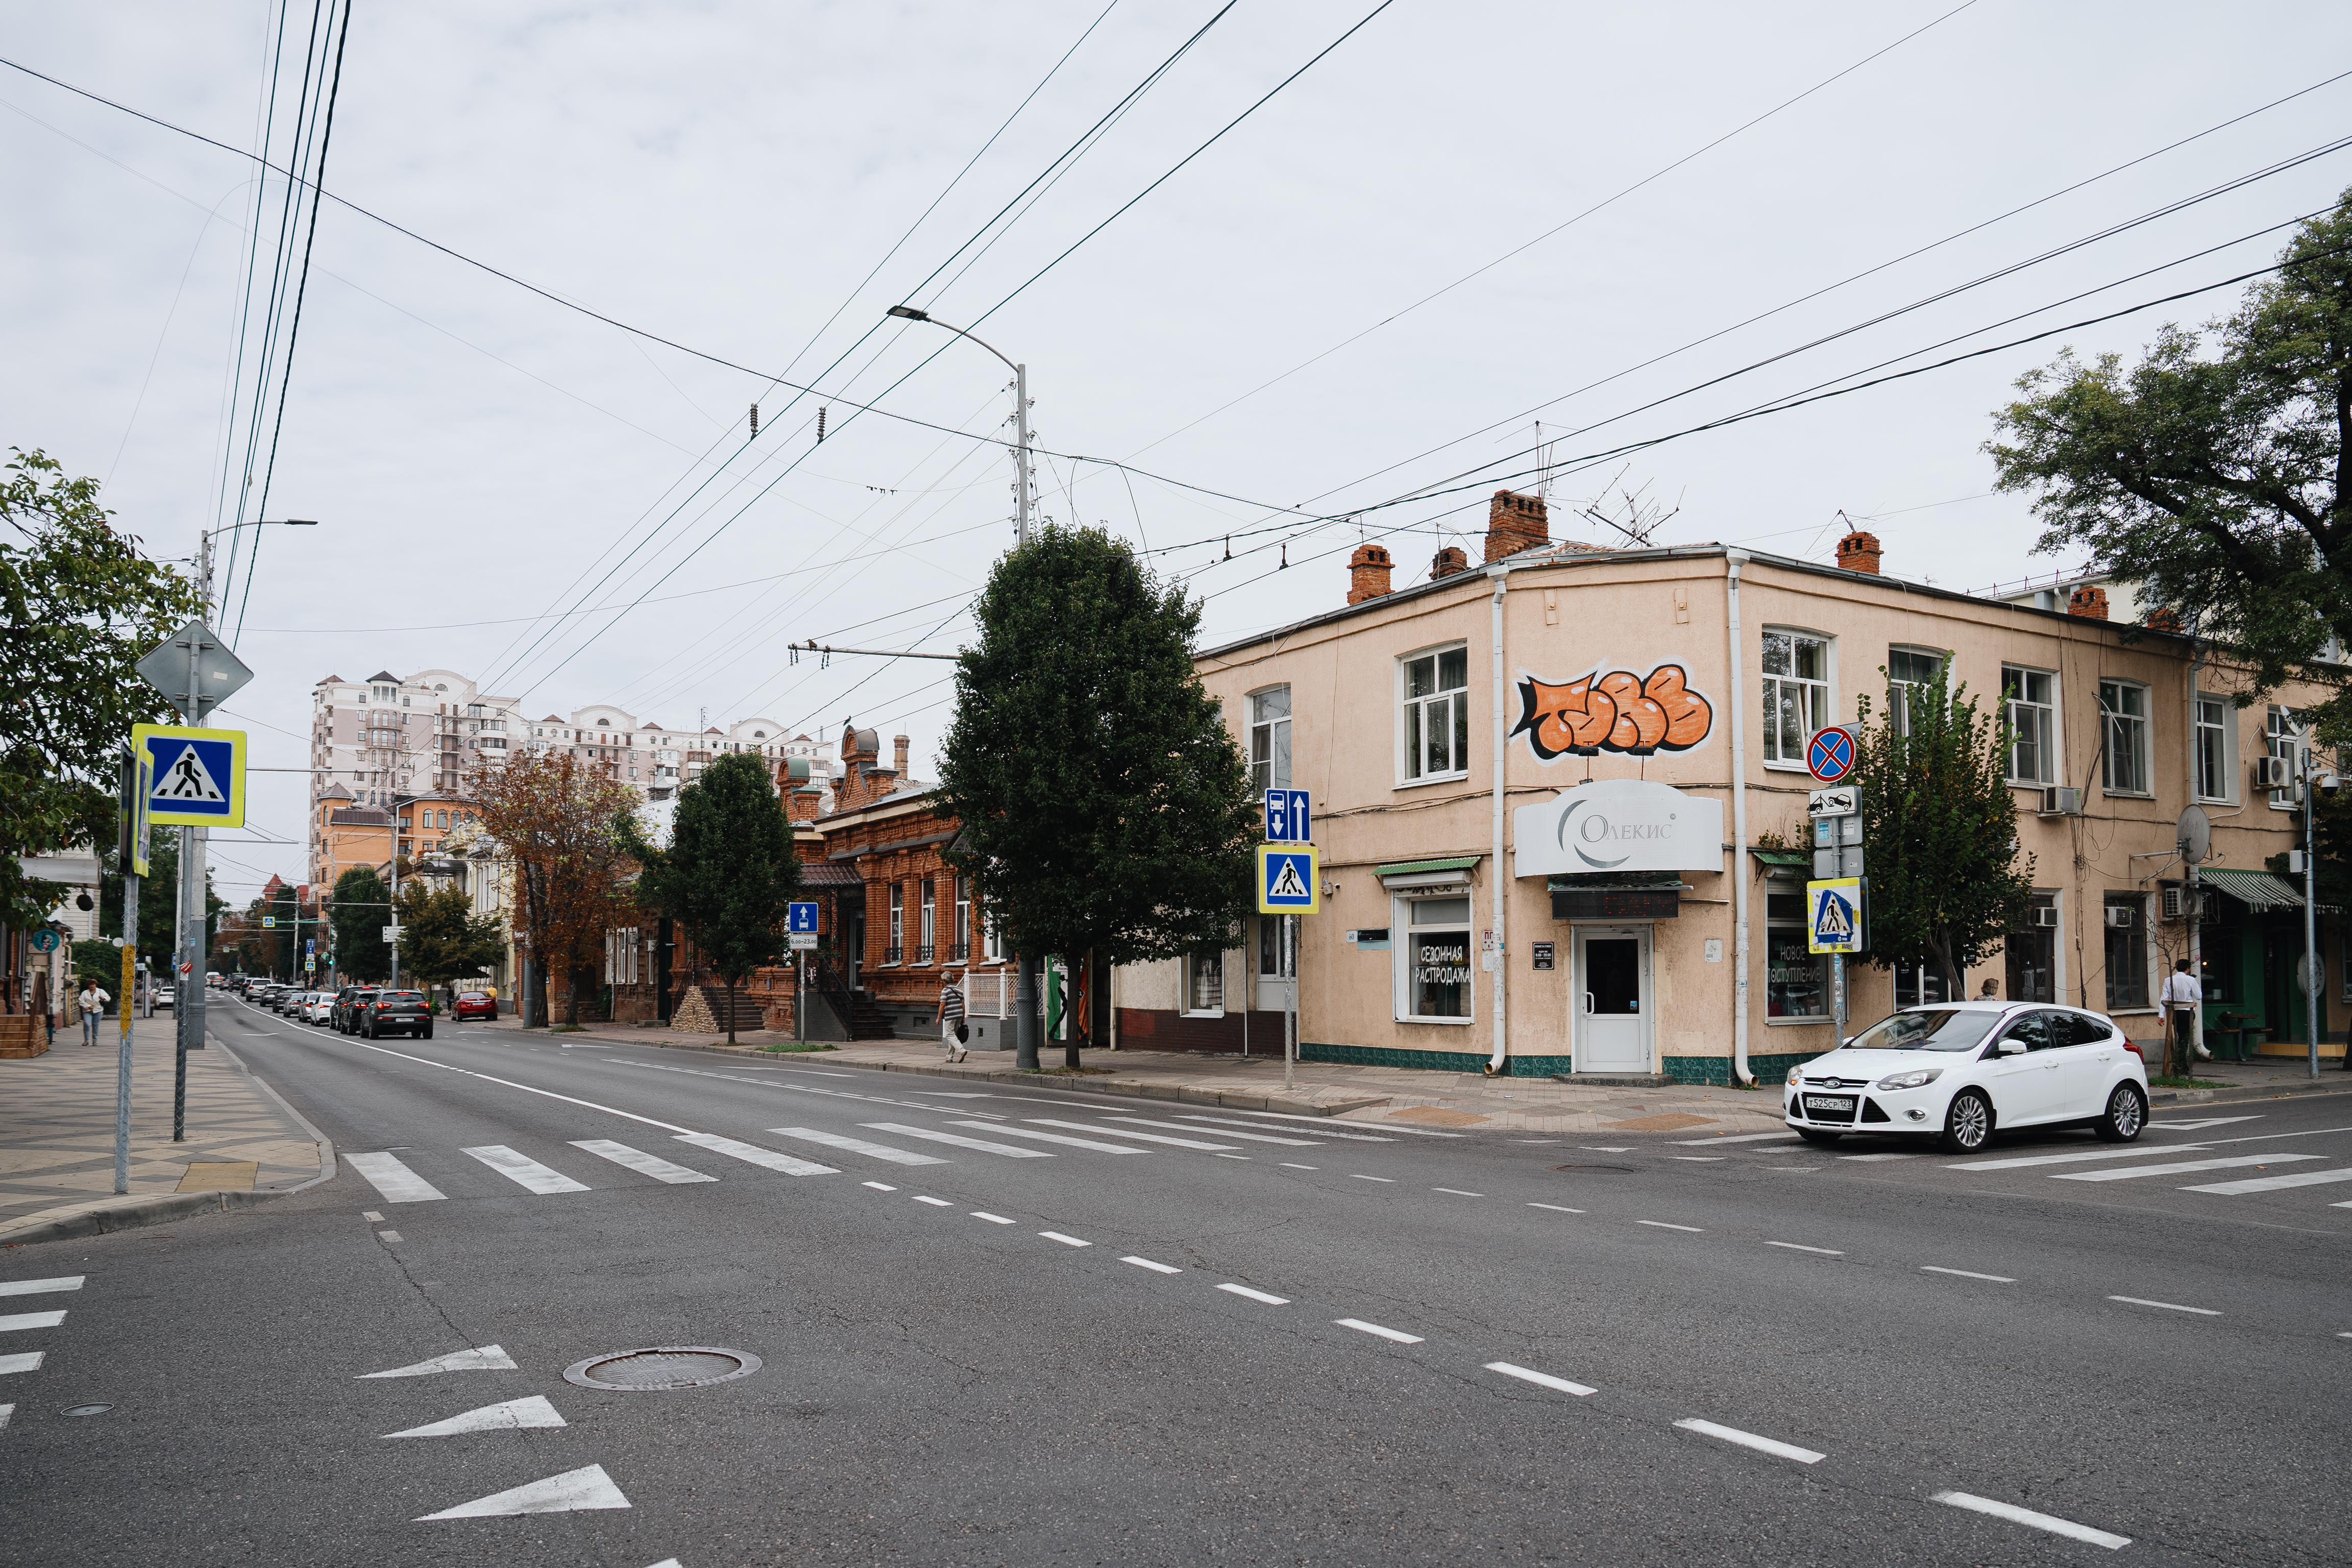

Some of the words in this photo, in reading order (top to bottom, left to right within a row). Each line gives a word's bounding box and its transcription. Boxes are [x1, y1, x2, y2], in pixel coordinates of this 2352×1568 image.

[1420, 945, 1462, 962] СЕЗОННАЯ
[1780, 945, 1805, 961] НОВОЕ
[1415, 967, 1470, 986] РАСПРОДАЖА
[1809, 1098, 1838, 1108] Т525СР
